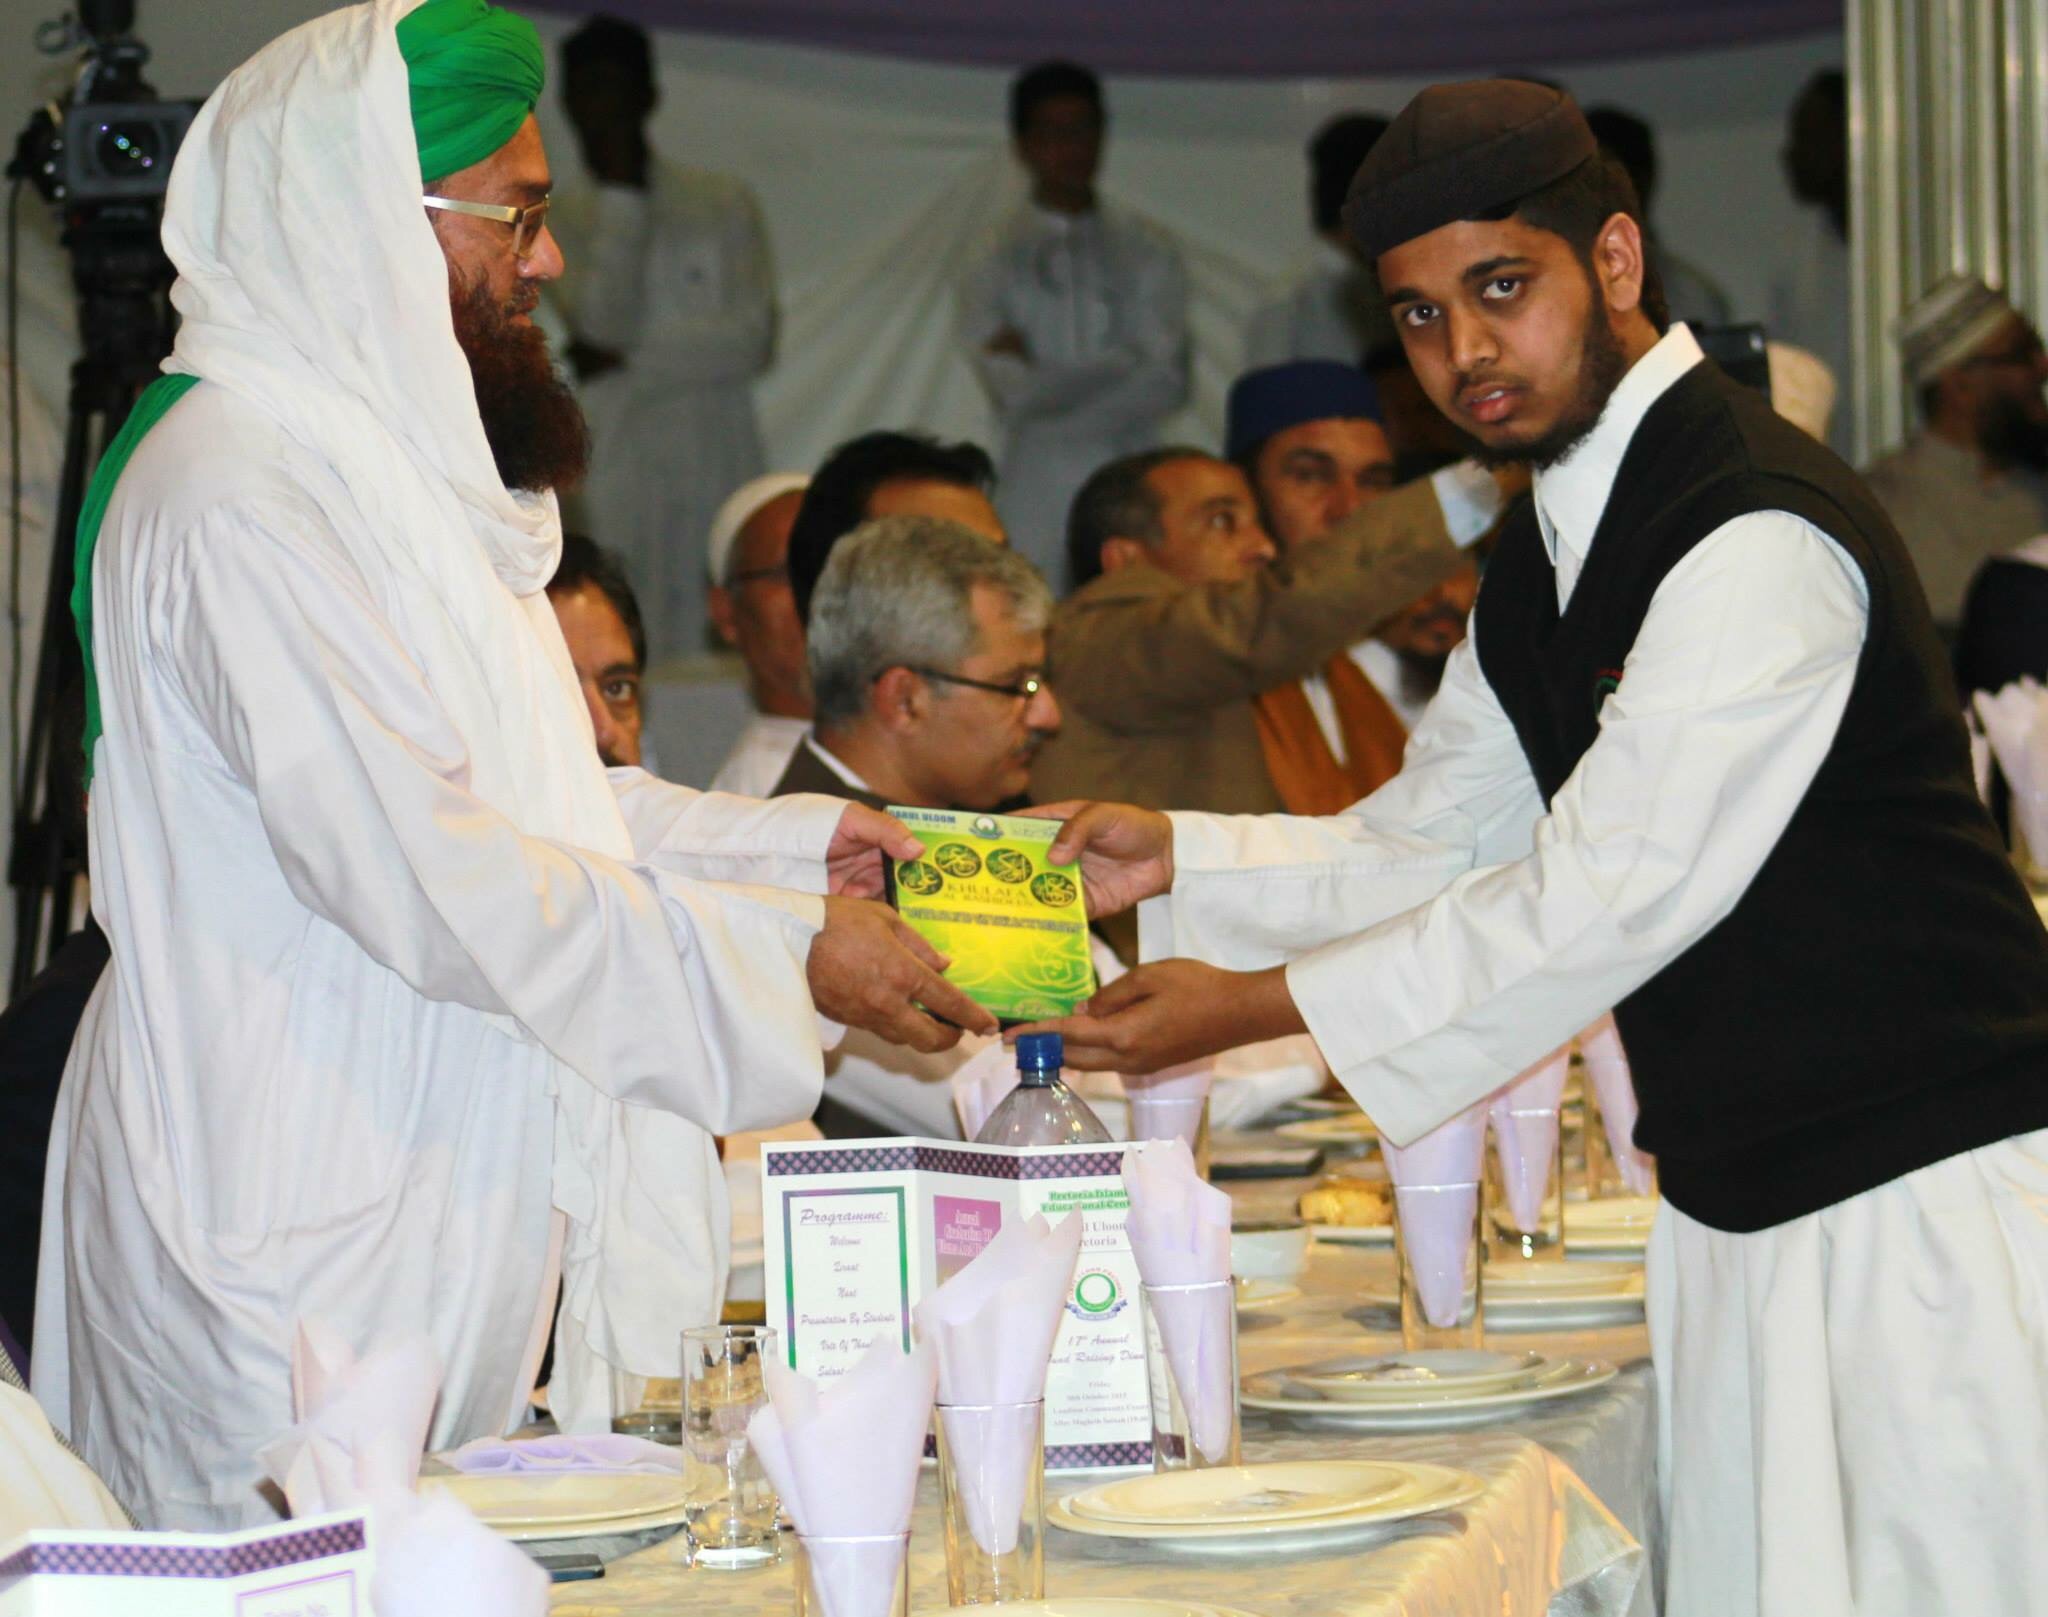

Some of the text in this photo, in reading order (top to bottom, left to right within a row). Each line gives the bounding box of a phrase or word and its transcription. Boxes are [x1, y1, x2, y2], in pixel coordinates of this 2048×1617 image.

[1095, 1188, 1129, 1199] Islami
[1041, 1199, 1131, 1212] Educaonal Cent
[800, 1208, 890, 1227] Programme:
[849, 1312, 861, 1328] By
[851, 1337, 873, 1350] Than
[1119, 1350, 1145, 1361] Dinn
